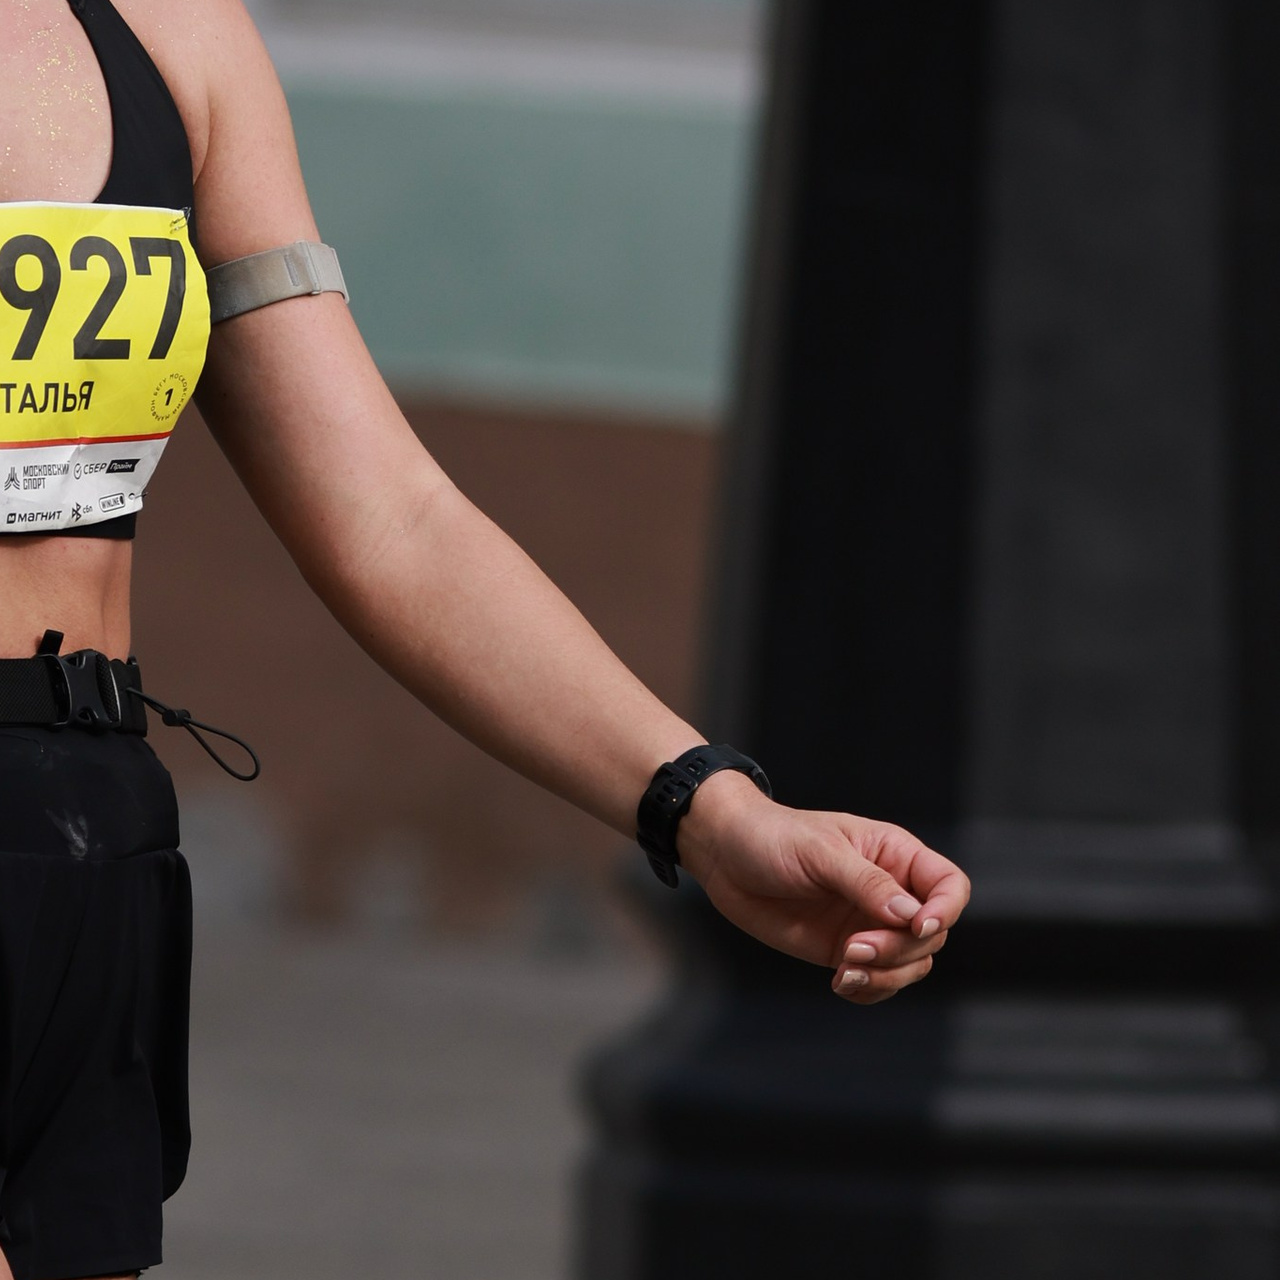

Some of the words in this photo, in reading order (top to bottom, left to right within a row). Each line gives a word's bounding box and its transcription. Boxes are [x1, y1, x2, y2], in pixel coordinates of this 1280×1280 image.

[164, 388, 174, 406] 1
[22, 460, 71, 477] МОСКОВСКИЙ
[83, 462, 108, 475] СБЕР
[22, 477, 46, 491] СПОРТ
